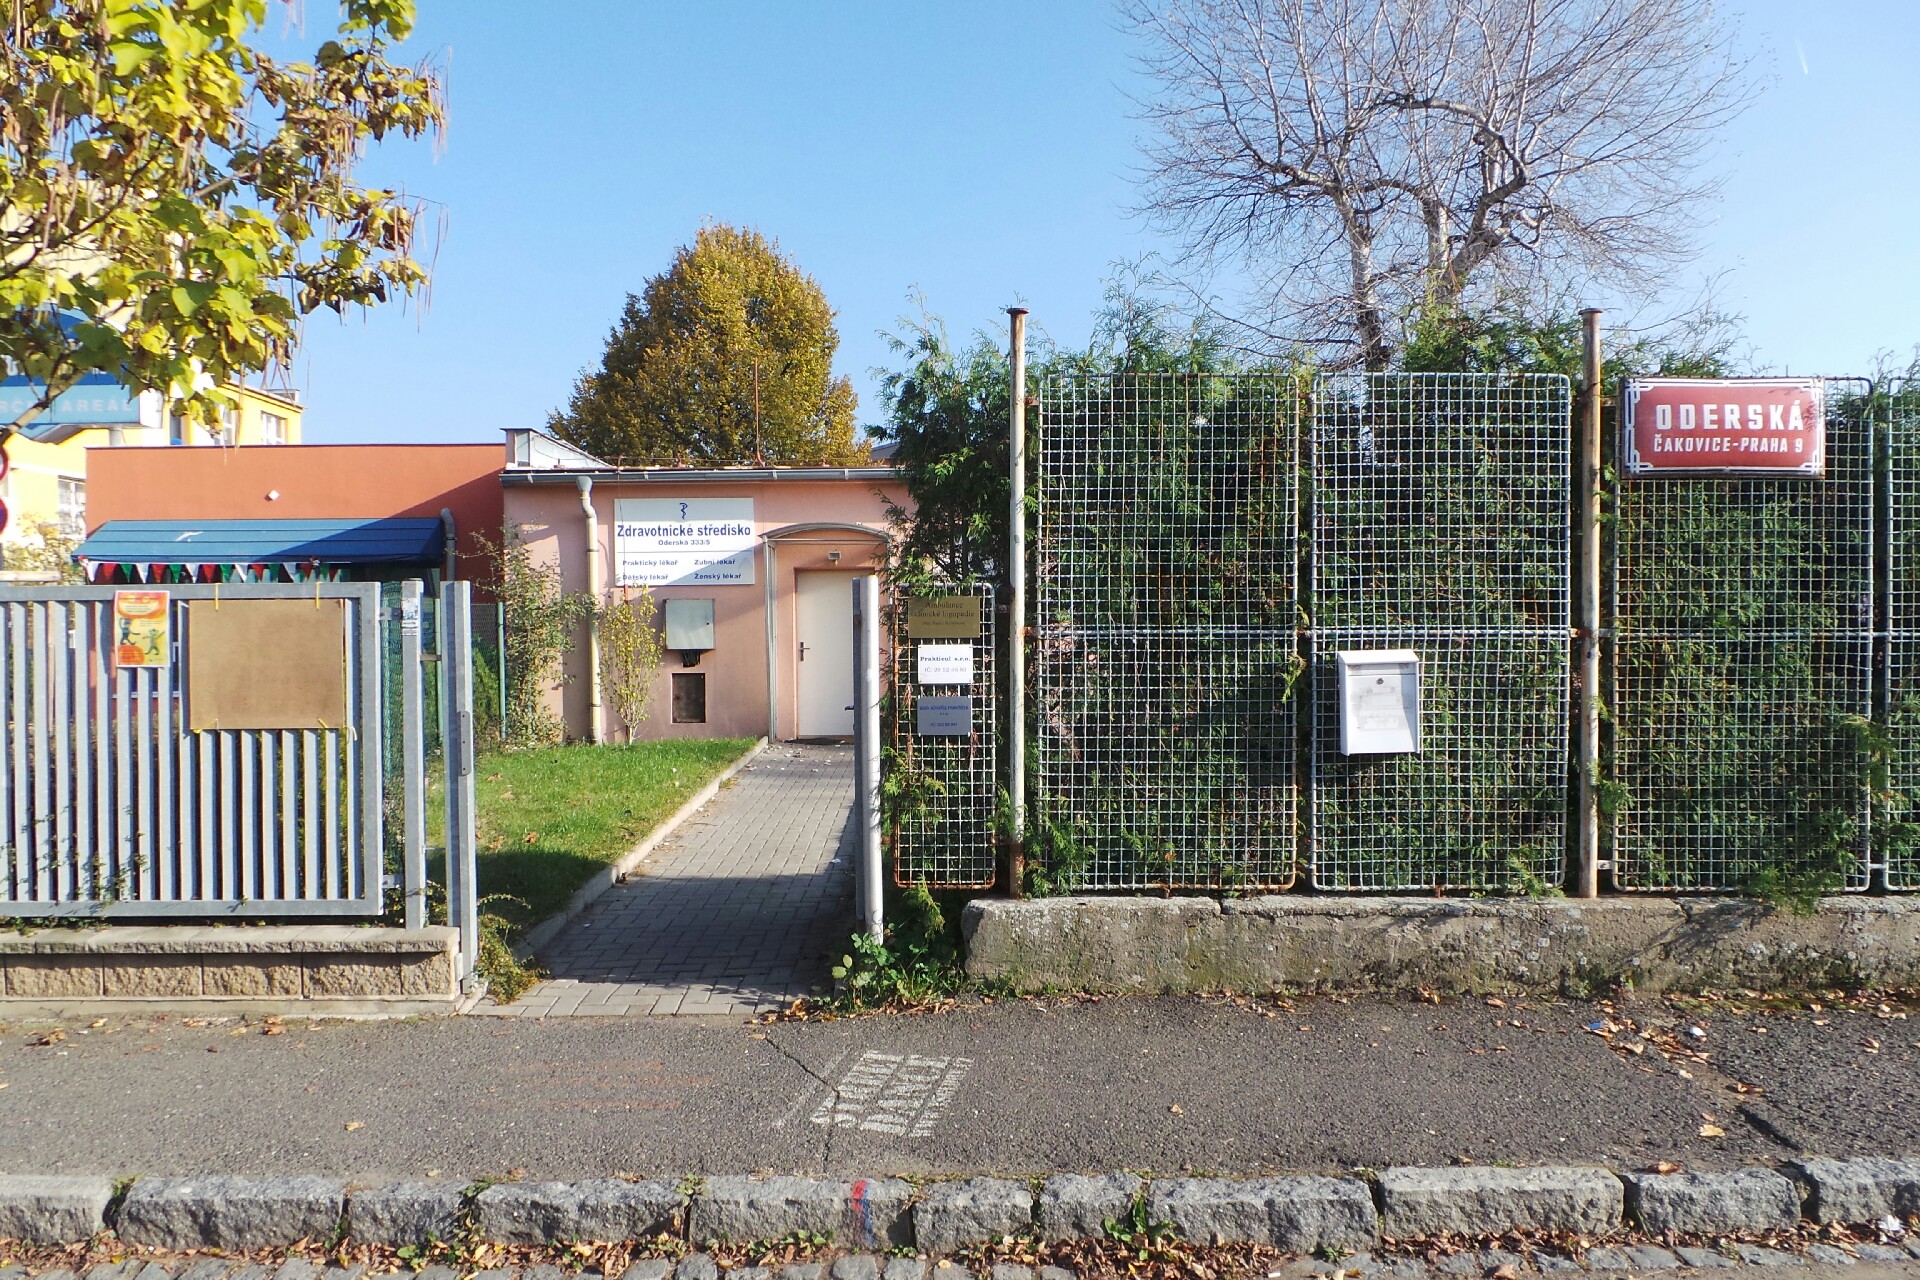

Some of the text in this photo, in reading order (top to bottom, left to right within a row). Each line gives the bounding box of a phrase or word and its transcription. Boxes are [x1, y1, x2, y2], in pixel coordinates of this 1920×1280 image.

[1655, 400, 1804, 431] ODERSKÁ
[1653, 434, 1804, 453] ČAKOVICE-PRAHA 9
[617, 523, 751, 537] Zdravotnické středisko
[622, 559, 658, 567] Praktický
[622, 573, 648, 581] Dětský
[694, 573, 721, 581] Ženský
[942, 609, 975, 619] logopedie
